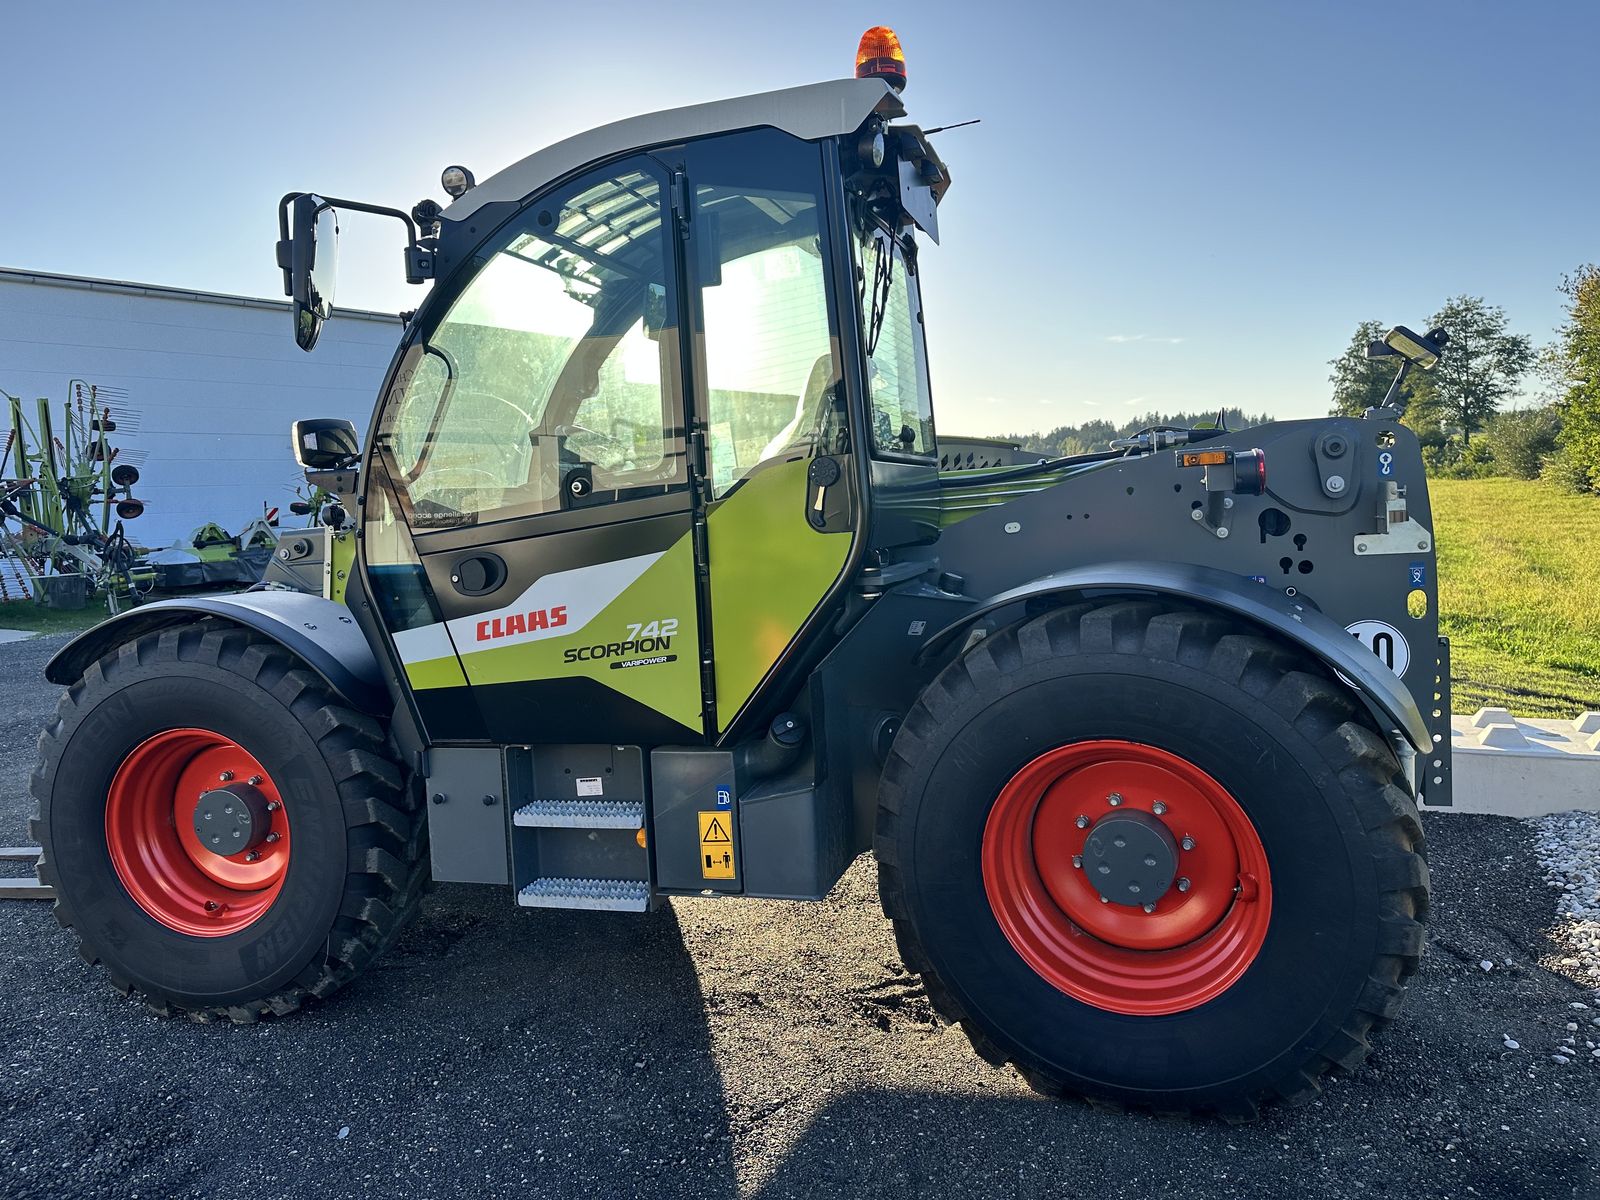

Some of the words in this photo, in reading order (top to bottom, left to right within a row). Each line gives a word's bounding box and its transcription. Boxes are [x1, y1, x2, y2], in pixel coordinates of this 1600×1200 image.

[476, 605, 567, 641] CLAAS
[626, 618, 679, 642] 742
[563, 635, 671, 663] SCORPION
[621, 656, 667, 668] VARIPOWER
[1351, 632, 1394, 671] 0
